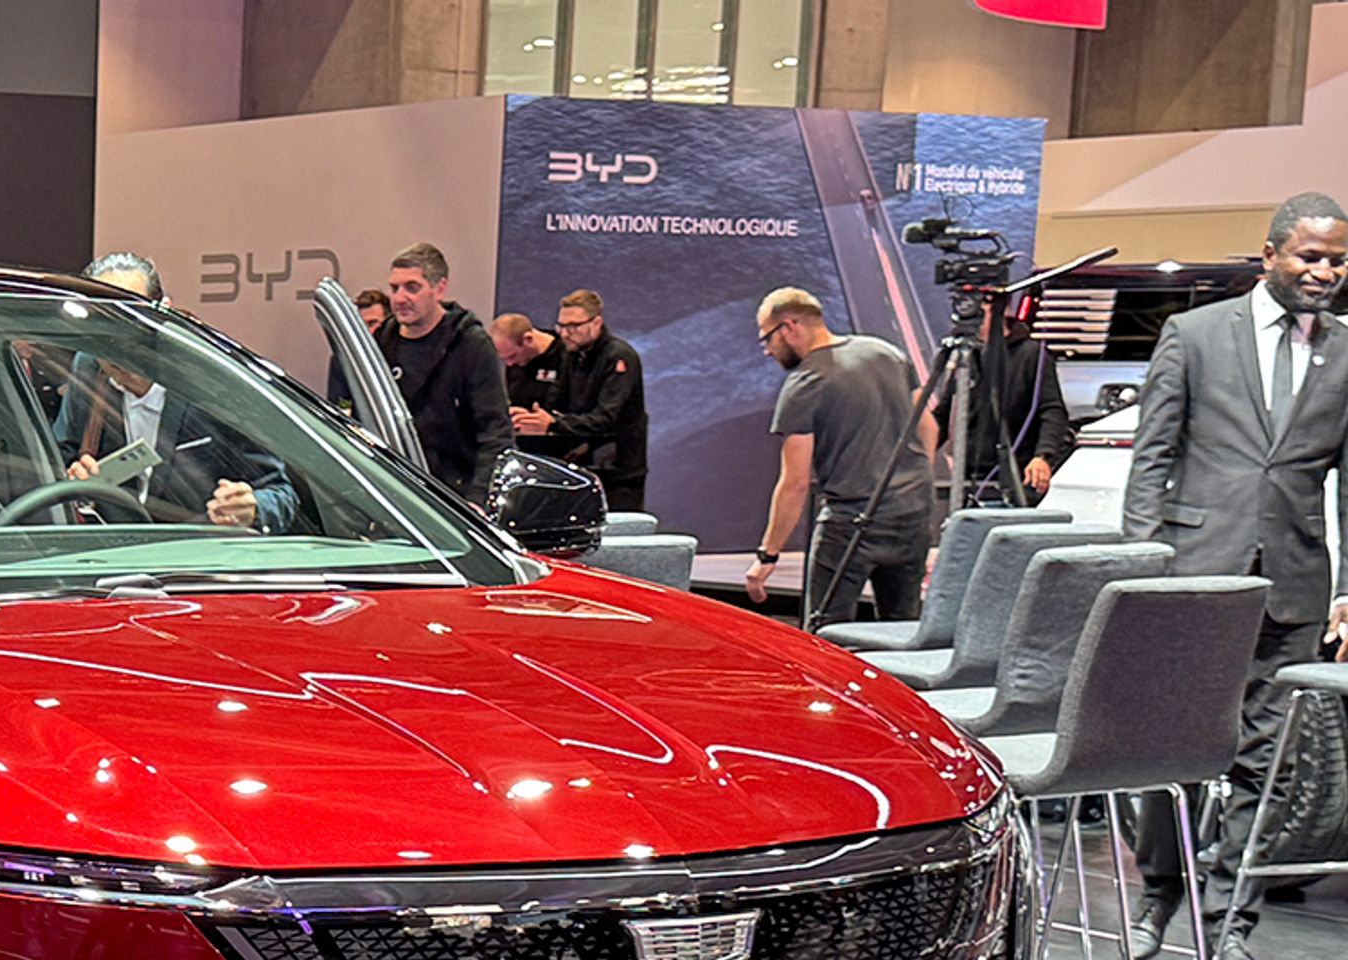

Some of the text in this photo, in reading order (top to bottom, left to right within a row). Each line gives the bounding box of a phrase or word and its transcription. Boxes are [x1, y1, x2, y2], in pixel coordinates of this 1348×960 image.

[548, 152, 658, 184] BYD
[924, 164, 966, 178] Mondial
[967, 165, 980, 179] du
[978, 180, 986, 193] &
[546, 213, 798, 237] L'INNOVATION TECHNOLOGIQUE
[200, 249, 340, 302] BYD
